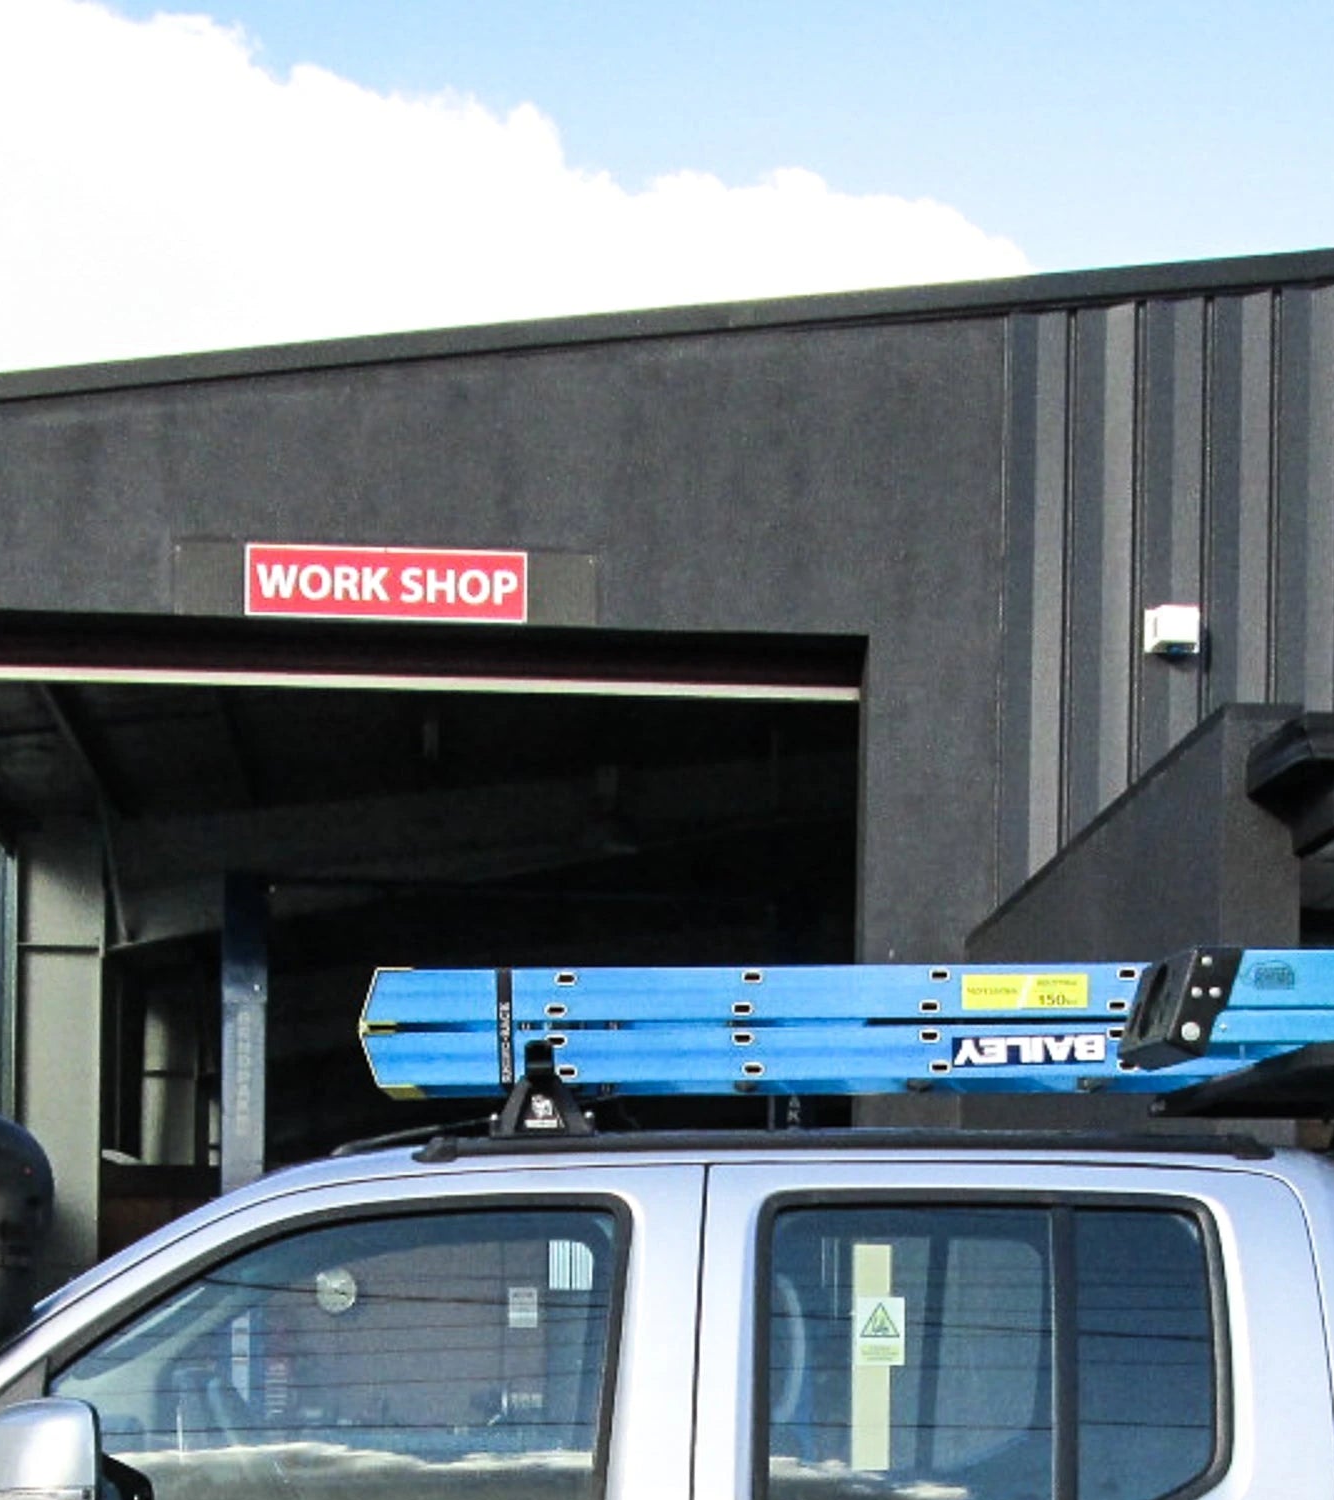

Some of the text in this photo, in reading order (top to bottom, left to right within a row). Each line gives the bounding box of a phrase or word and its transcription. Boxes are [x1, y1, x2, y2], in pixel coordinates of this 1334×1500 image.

[256, 563, 518, 605] WORK SHOP
[954, 1034, 1106, 1066] BAILEY
